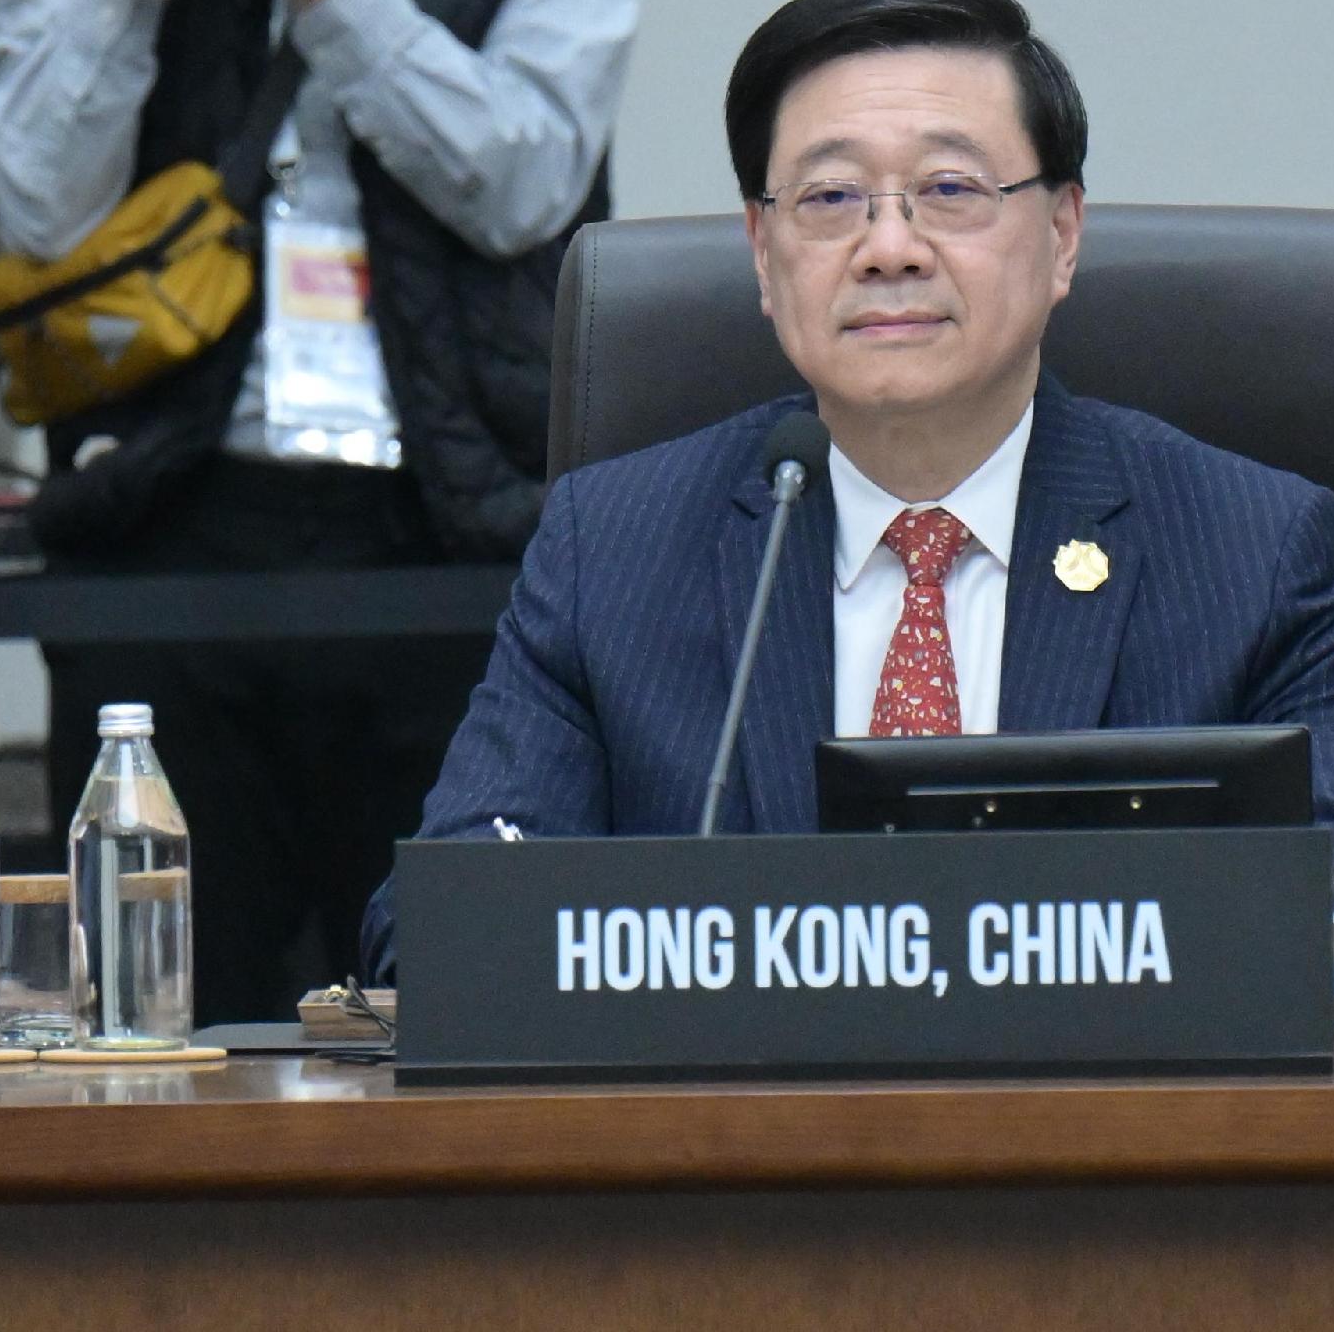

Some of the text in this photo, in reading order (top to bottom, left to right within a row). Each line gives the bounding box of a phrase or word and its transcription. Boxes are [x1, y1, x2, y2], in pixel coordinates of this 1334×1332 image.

[556, 901, 1173, 999] HONG KONG, CHINA
